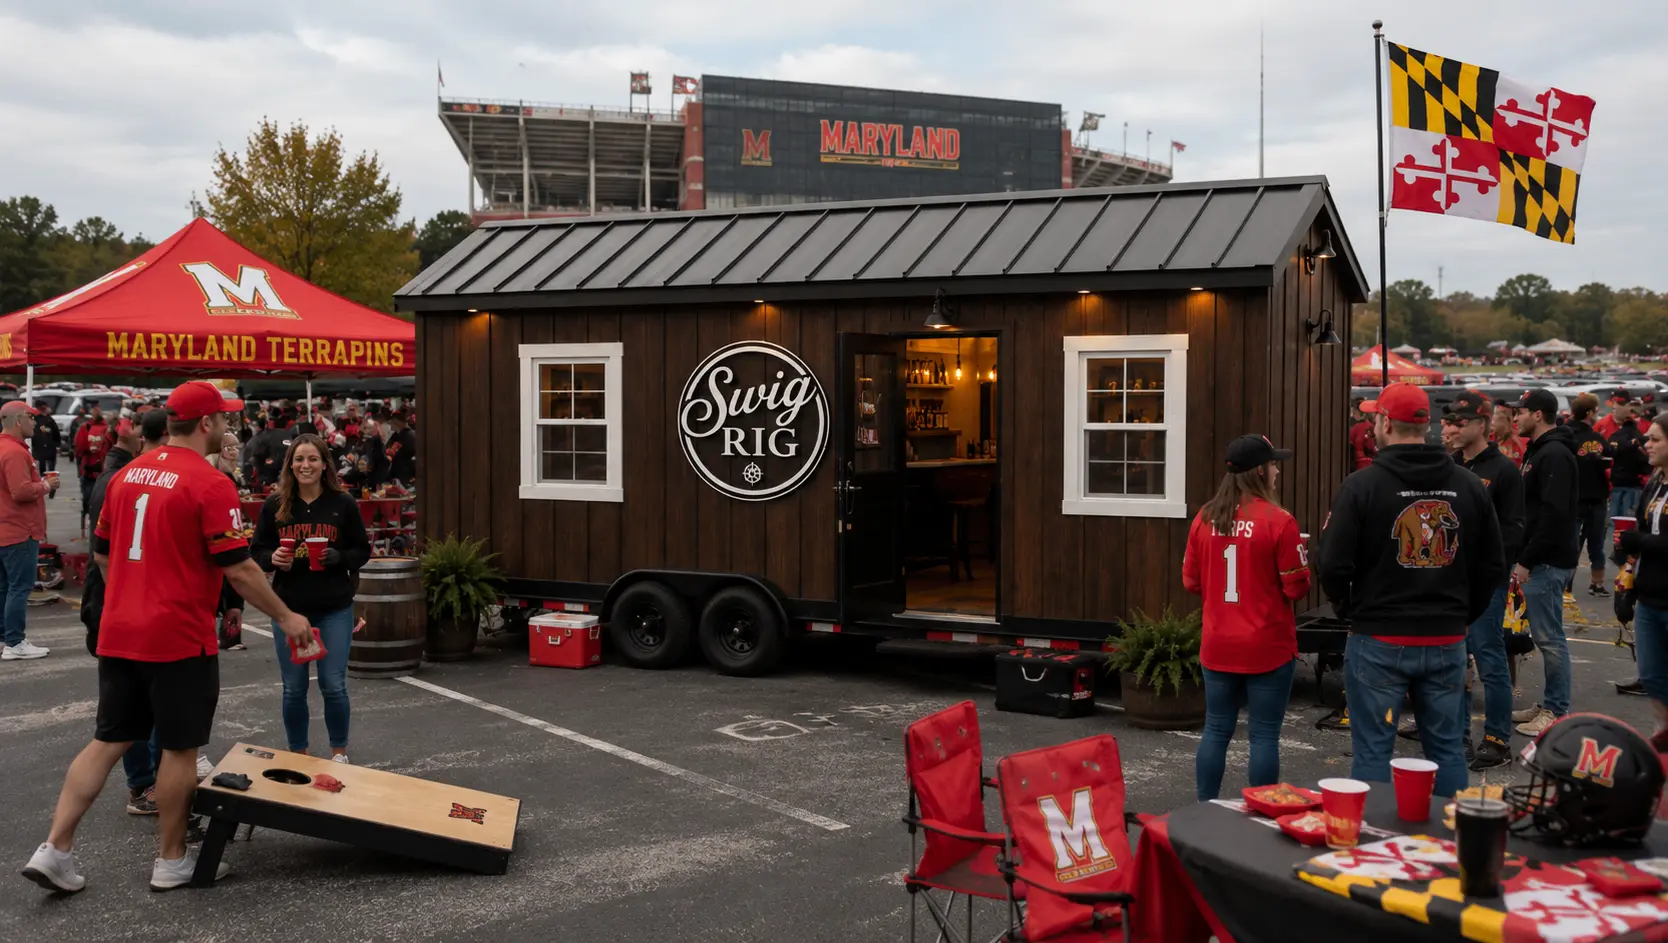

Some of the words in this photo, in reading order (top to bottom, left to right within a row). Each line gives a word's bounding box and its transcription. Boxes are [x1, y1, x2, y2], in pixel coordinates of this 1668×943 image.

[741, 128, 773, 164] M
[820, 119, 960, 160] MARYLAND
[179, 260, 298, 315] M
[106, 331, 257, 361] MARYLAND
[266, 336, 404, 367] TERRAPINS
[681, 366, 817, 438] Swig
[721, 427, 799, 457] RIG
[123, 467, 179, 489] MARYLAND
[128, 493, 150, 562] 1
[1211, 519, 1254, 539] TRPS
[1223, 544, 1239, 603] 1
[1573, 736, 1623, 785] M
[1037, 786, 1114, 873] M
